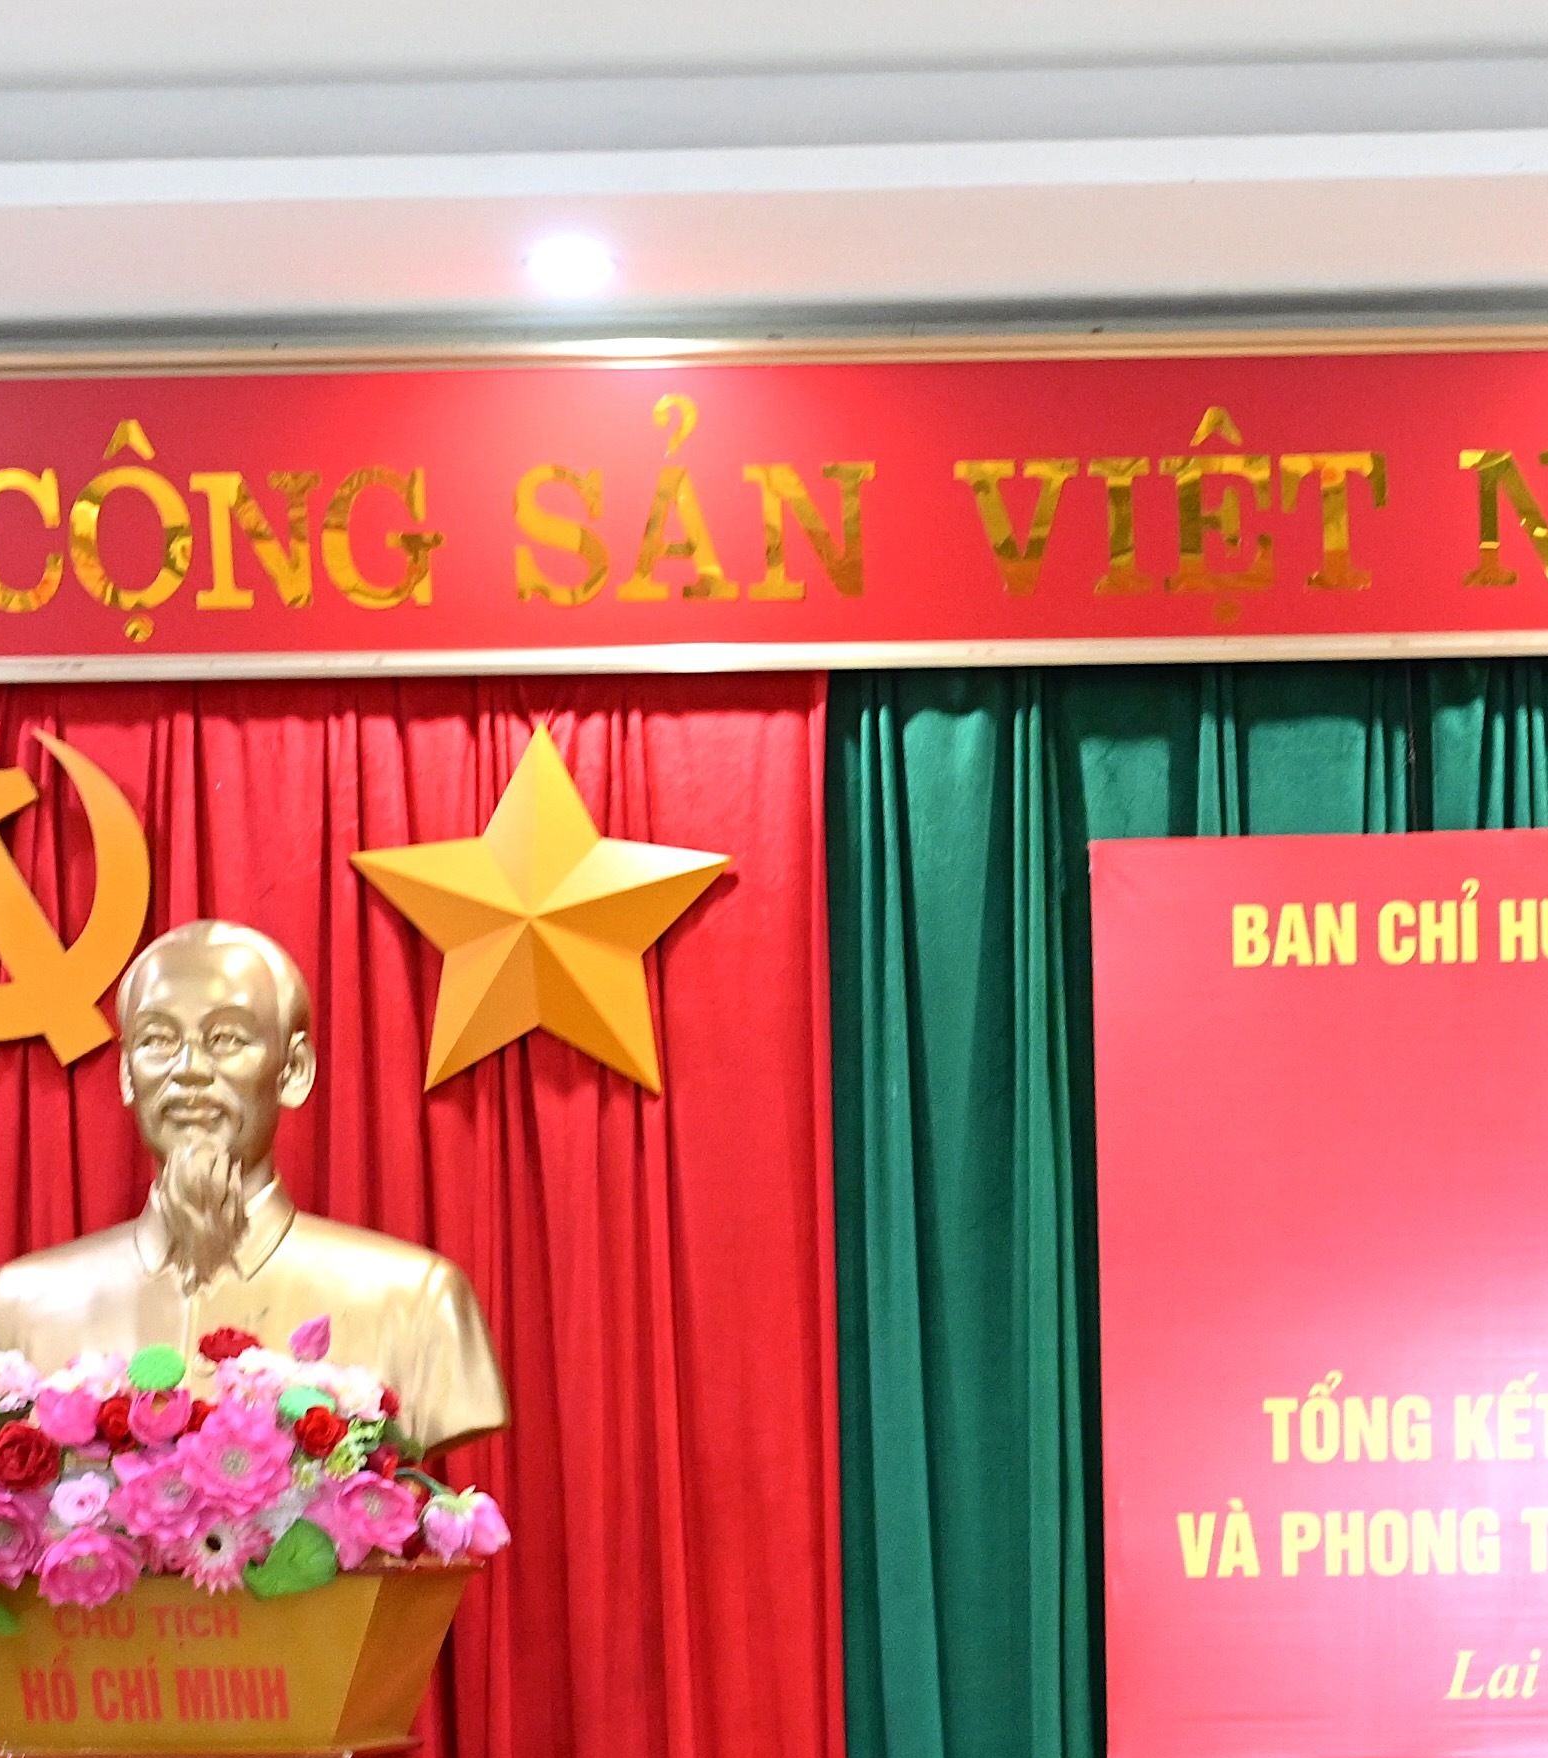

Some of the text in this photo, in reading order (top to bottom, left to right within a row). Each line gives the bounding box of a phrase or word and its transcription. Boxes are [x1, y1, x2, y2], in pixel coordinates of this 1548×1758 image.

[512, 394, 875, 605] SẢN
[953, 406, 1387, 625] VIỆT
[1232, 902, 1357, 967] BAN
[1377, 877, 1480, 964] CHỈ
[1263, 1372, 1432, 1464] TỔNG
[1176, 1499, 1260, 1580] VÀ
[1280, 1509, 1502, 1579] PHONG
[149, 1606, 241, 1648] TỊCH
[92, 1653, 162, 1722] CHÍ
[174, 1666, 289, 1721] MINH
[1445, 1649, 1541, 1700] Lai
